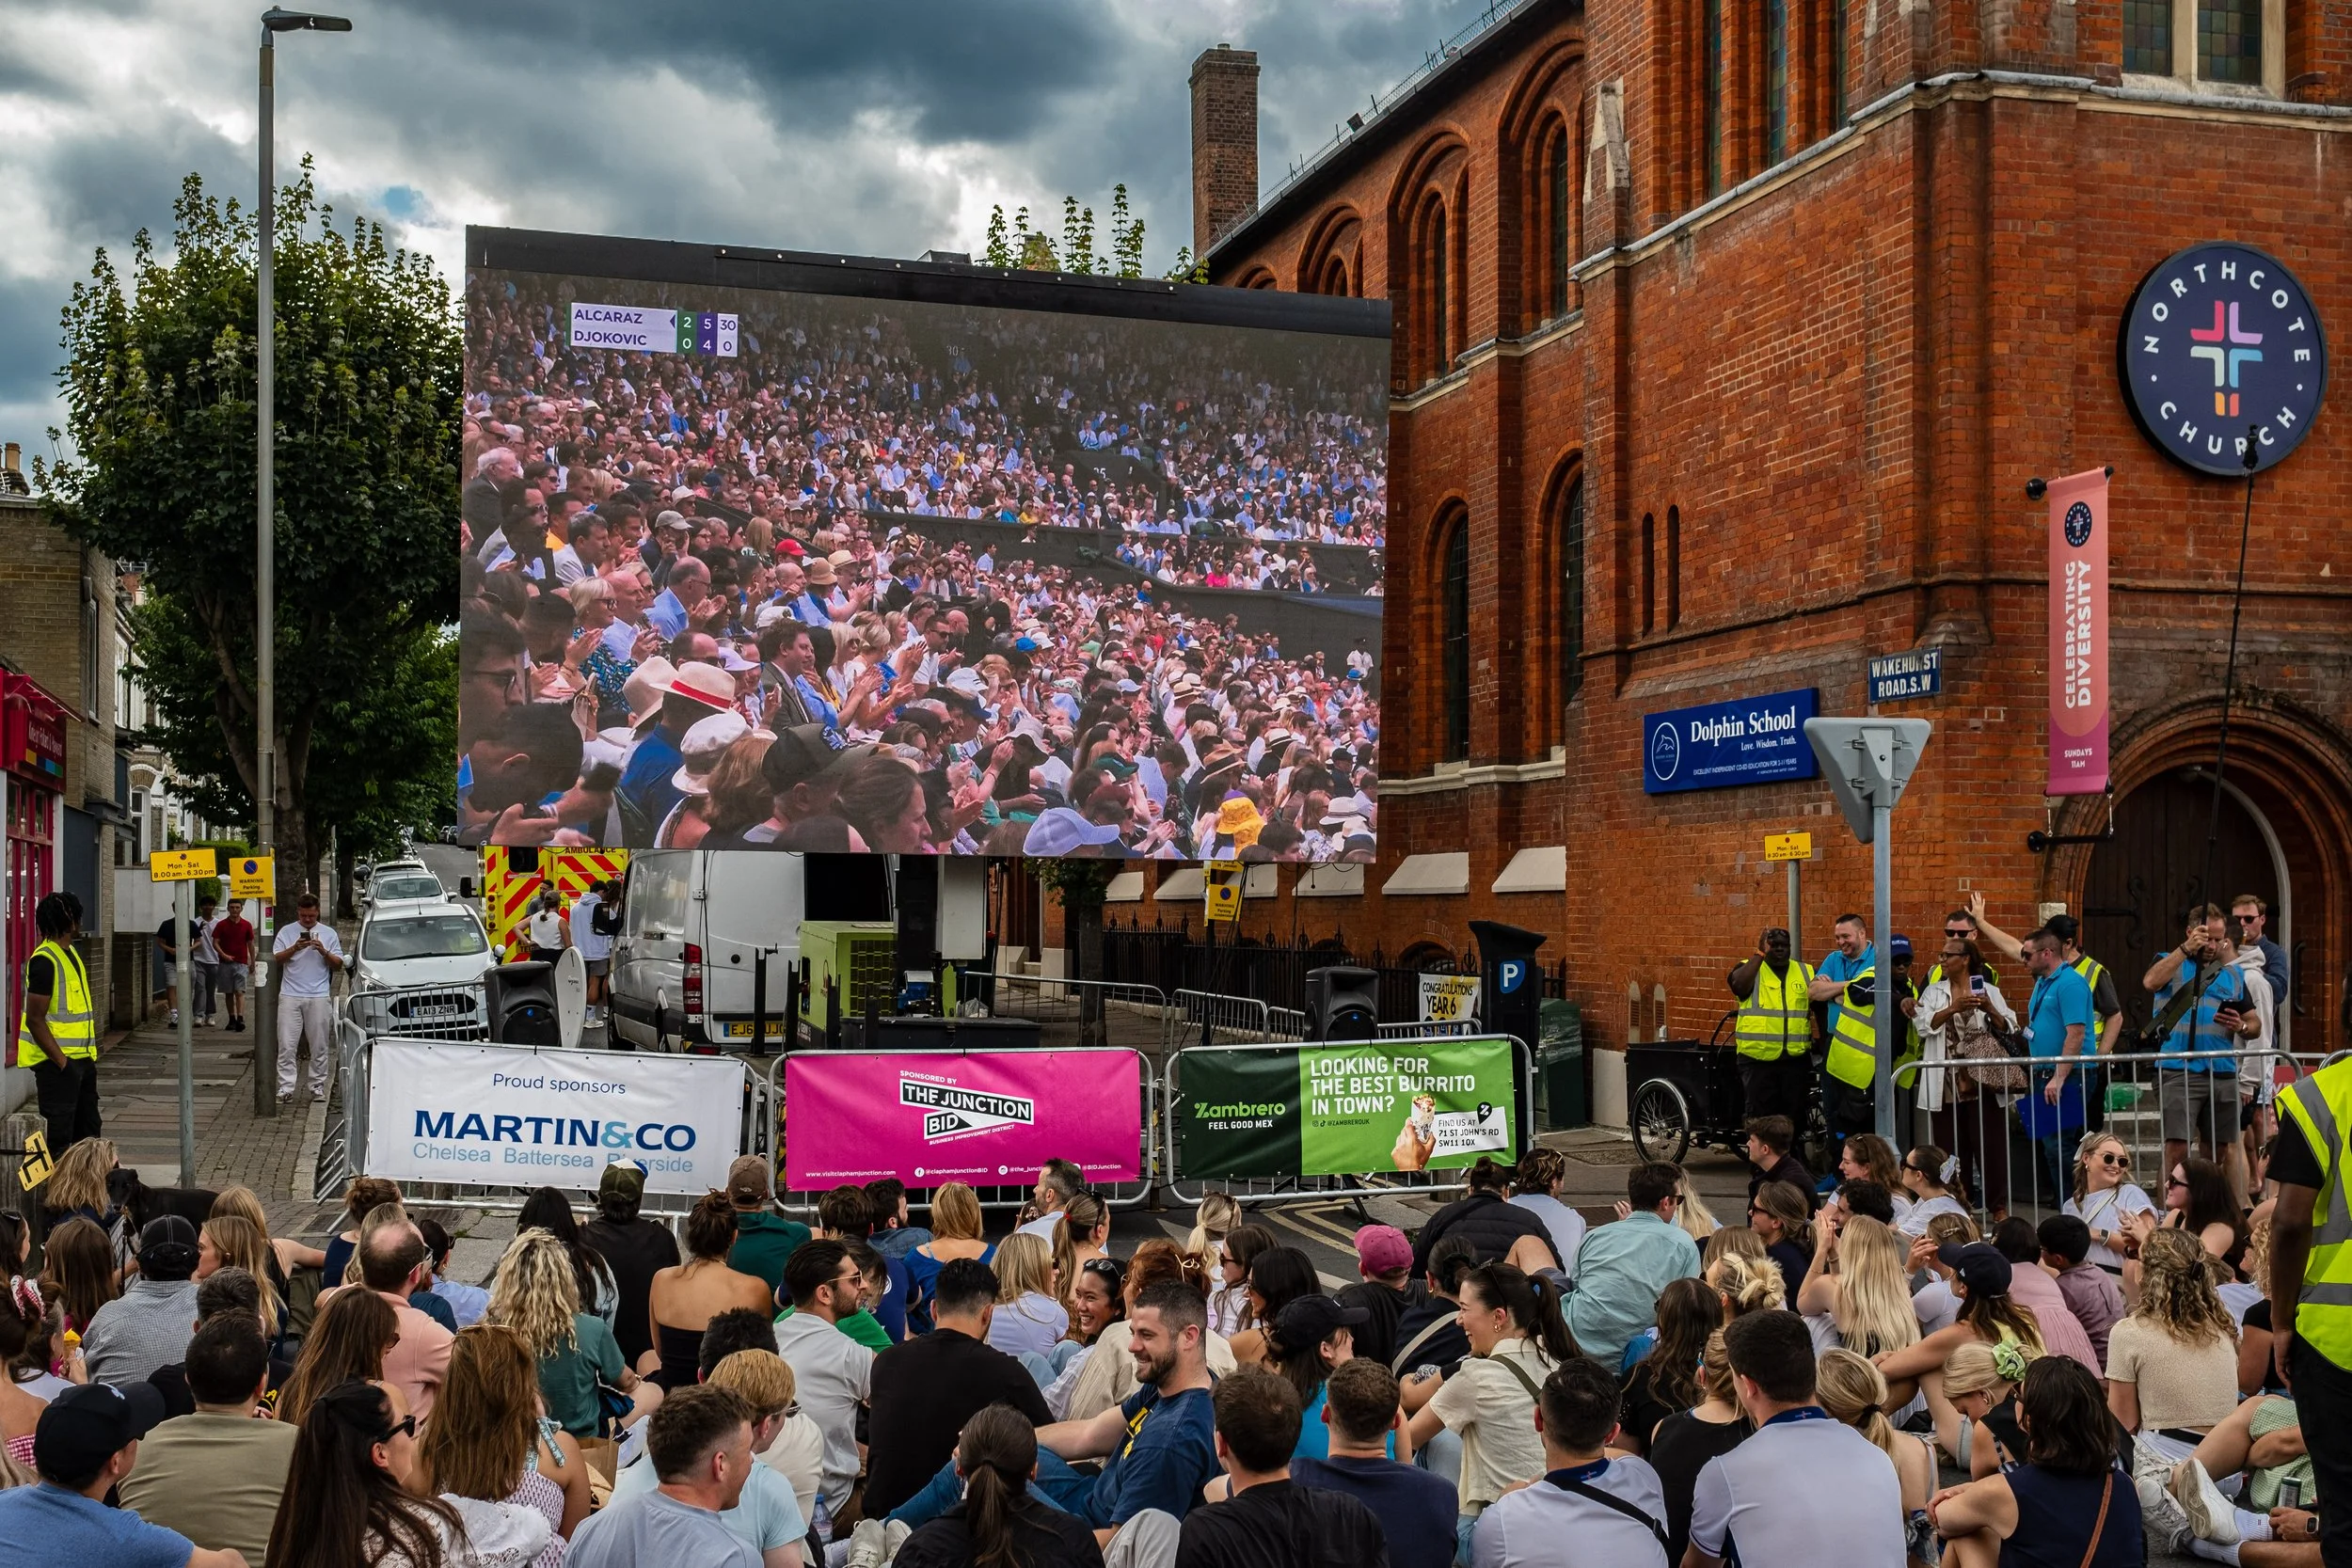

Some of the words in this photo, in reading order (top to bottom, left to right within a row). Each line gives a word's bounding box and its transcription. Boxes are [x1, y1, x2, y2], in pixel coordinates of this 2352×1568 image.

[574, 309, 644, 325] ALCARAZ
[683, 316, 691, 328] 2
[704, 318, 711, 329] 5
[720, 320, 737, 331] 30
[2144, 261, 2311, 362] NORTHCOTE
[574, 330, 647, 346] DJOKOVIC
[682, 339, 691, 350] 0
[703, 340, 711, 351] 4
[723, 341, 732, 352] 0
[2160, 401, 2296, 456] CHURCH
[2065, 561, 2075, 708] CELEBRATING
[2077, 560, 2091, 706] DIVERSITY
[1691, 715, 1744, 747] Dolphin
[1749, 705, 1796, 735] School
[1740, 741, 1755, 752] Love.
[1756, 738, 1778, 749] Wisdom.
[2064, 747, 2092, 758] SUNDAYS
[2071, 760, 2086, 768] 11AM
[564, 847, 616, 855] AMBULANCE
[1503, 963, 1518, 988] P
[1422, 981, 1473, 996] CONGRATULATIONS
[1426, 994, 1448, 1014] YEAR
[1450, 997, 1456, 1016] 6
[731, 1024, 754, 1036] EJ6
[899, 1069, 946, 1084] SPONSORED
[946, 1077, 957, 1085] BY
[1310, 1056, 1389, 1077] LOOKING
[1393, 1056, 1429, 1074] FOR
[493, 1073, 544, 1089] Proud
[549, 1078, 626, 1095] sponsors
[1310, 1077, 1345, 1096] THE
[1350, 1075, 1394, 1094] BEST
[1399, 1074, 1475, 1093] BURRITO
[904, 1085, 939, 1103] THE
[940, 1091, 1029, 1119] JUNCTION
[1194, 1101, 1286, 1118] Zambrero
[1311, 1097, 1329, 1116] IN
[1333, 1095, 1395, 1115] TOWN?
[414, 1110, 697, 1152] MARTIN&CO
[929, 1114, 959, 1133] BID
[1208, 1121, 1229, 1130] FEEL
[1231, 1120, 1253, 1129] GOOD
[1255, 1119, 1273, 1128] MEX
[1460, 1128, 1486, 1136] JOHN'S
[1488, 1128, 1500, 1136] RD
[929, 1136, 954, 1146] BUSINESS
[954, 1129, 992, 1140] IMPROVEMENT
[992, 1124, 1015, 1134] DISTRICT
[1438, 1139, 1459, 1148] SW11
[413, 1142, 491, 1163] Chelsea
[503, 1148, 594, 1168] Battersea
[607, 1152, 693, 1173] Rerside
[805, 1169, 897, 1178] www.visitclaphamjunction.com
